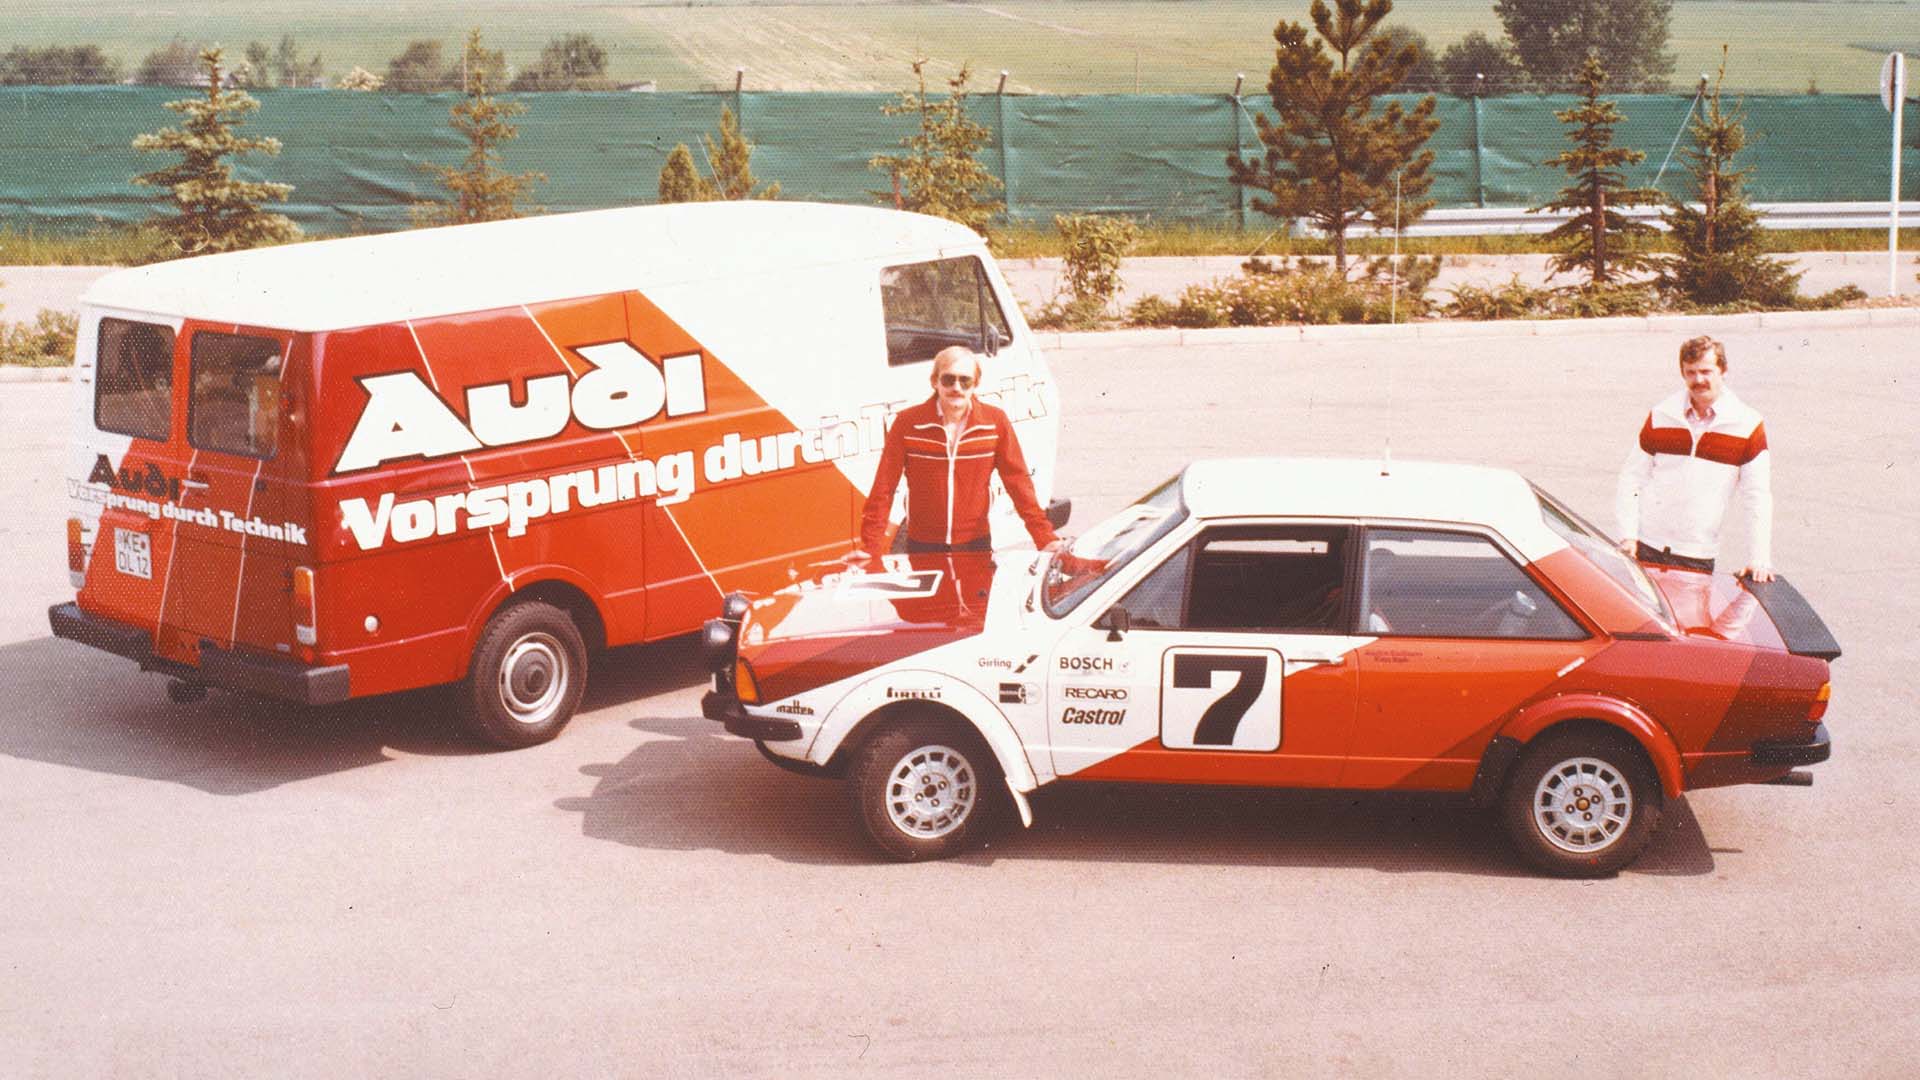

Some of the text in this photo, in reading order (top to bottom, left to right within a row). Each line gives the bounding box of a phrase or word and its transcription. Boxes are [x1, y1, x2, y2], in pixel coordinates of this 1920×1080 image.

[330, 340, 706, 475] Audi
[88, 453, 180, 500] Audi
[339, 414, 860, 552] Vorsprung durch
[67, 478, 308, 545] Vorsprung durch Technik
[978, 658, 1012, 670] Girling
[1060, 656, 1113, 670] BOSCH
[886, 687, 942, 698] PIRELLI
[1065, 687, 1128, 700] RECARO
[1173, 654, 1268, 746] 7
[1062, 707, 1126, 726] Castrol
